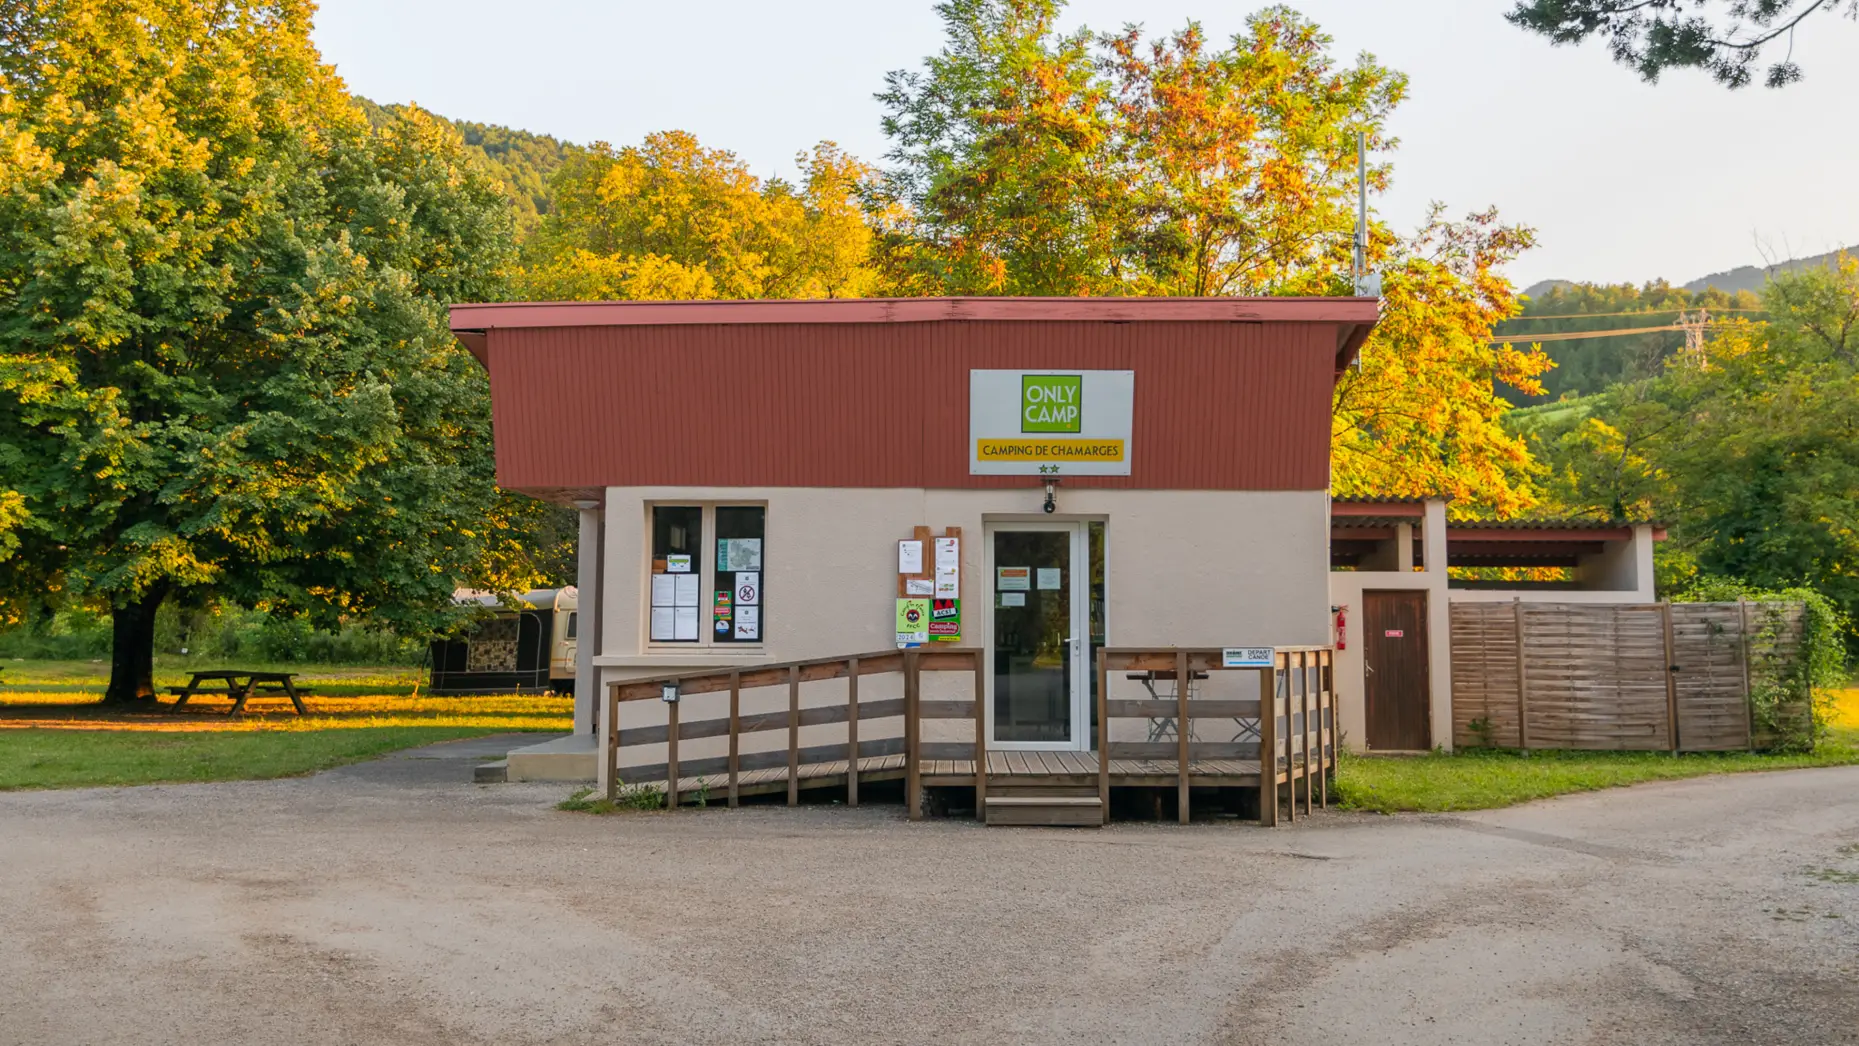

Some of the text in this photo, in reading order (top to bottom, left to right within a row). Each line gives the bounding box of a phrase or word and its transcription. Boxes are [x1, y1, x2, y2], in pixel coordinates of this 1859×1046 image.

[1026, 385, 1077, 403] ONLY
[1024, 405, 1077, 423] CAMP
[983, 445, 1119, 456] CAMPING DE CHAMARGES
